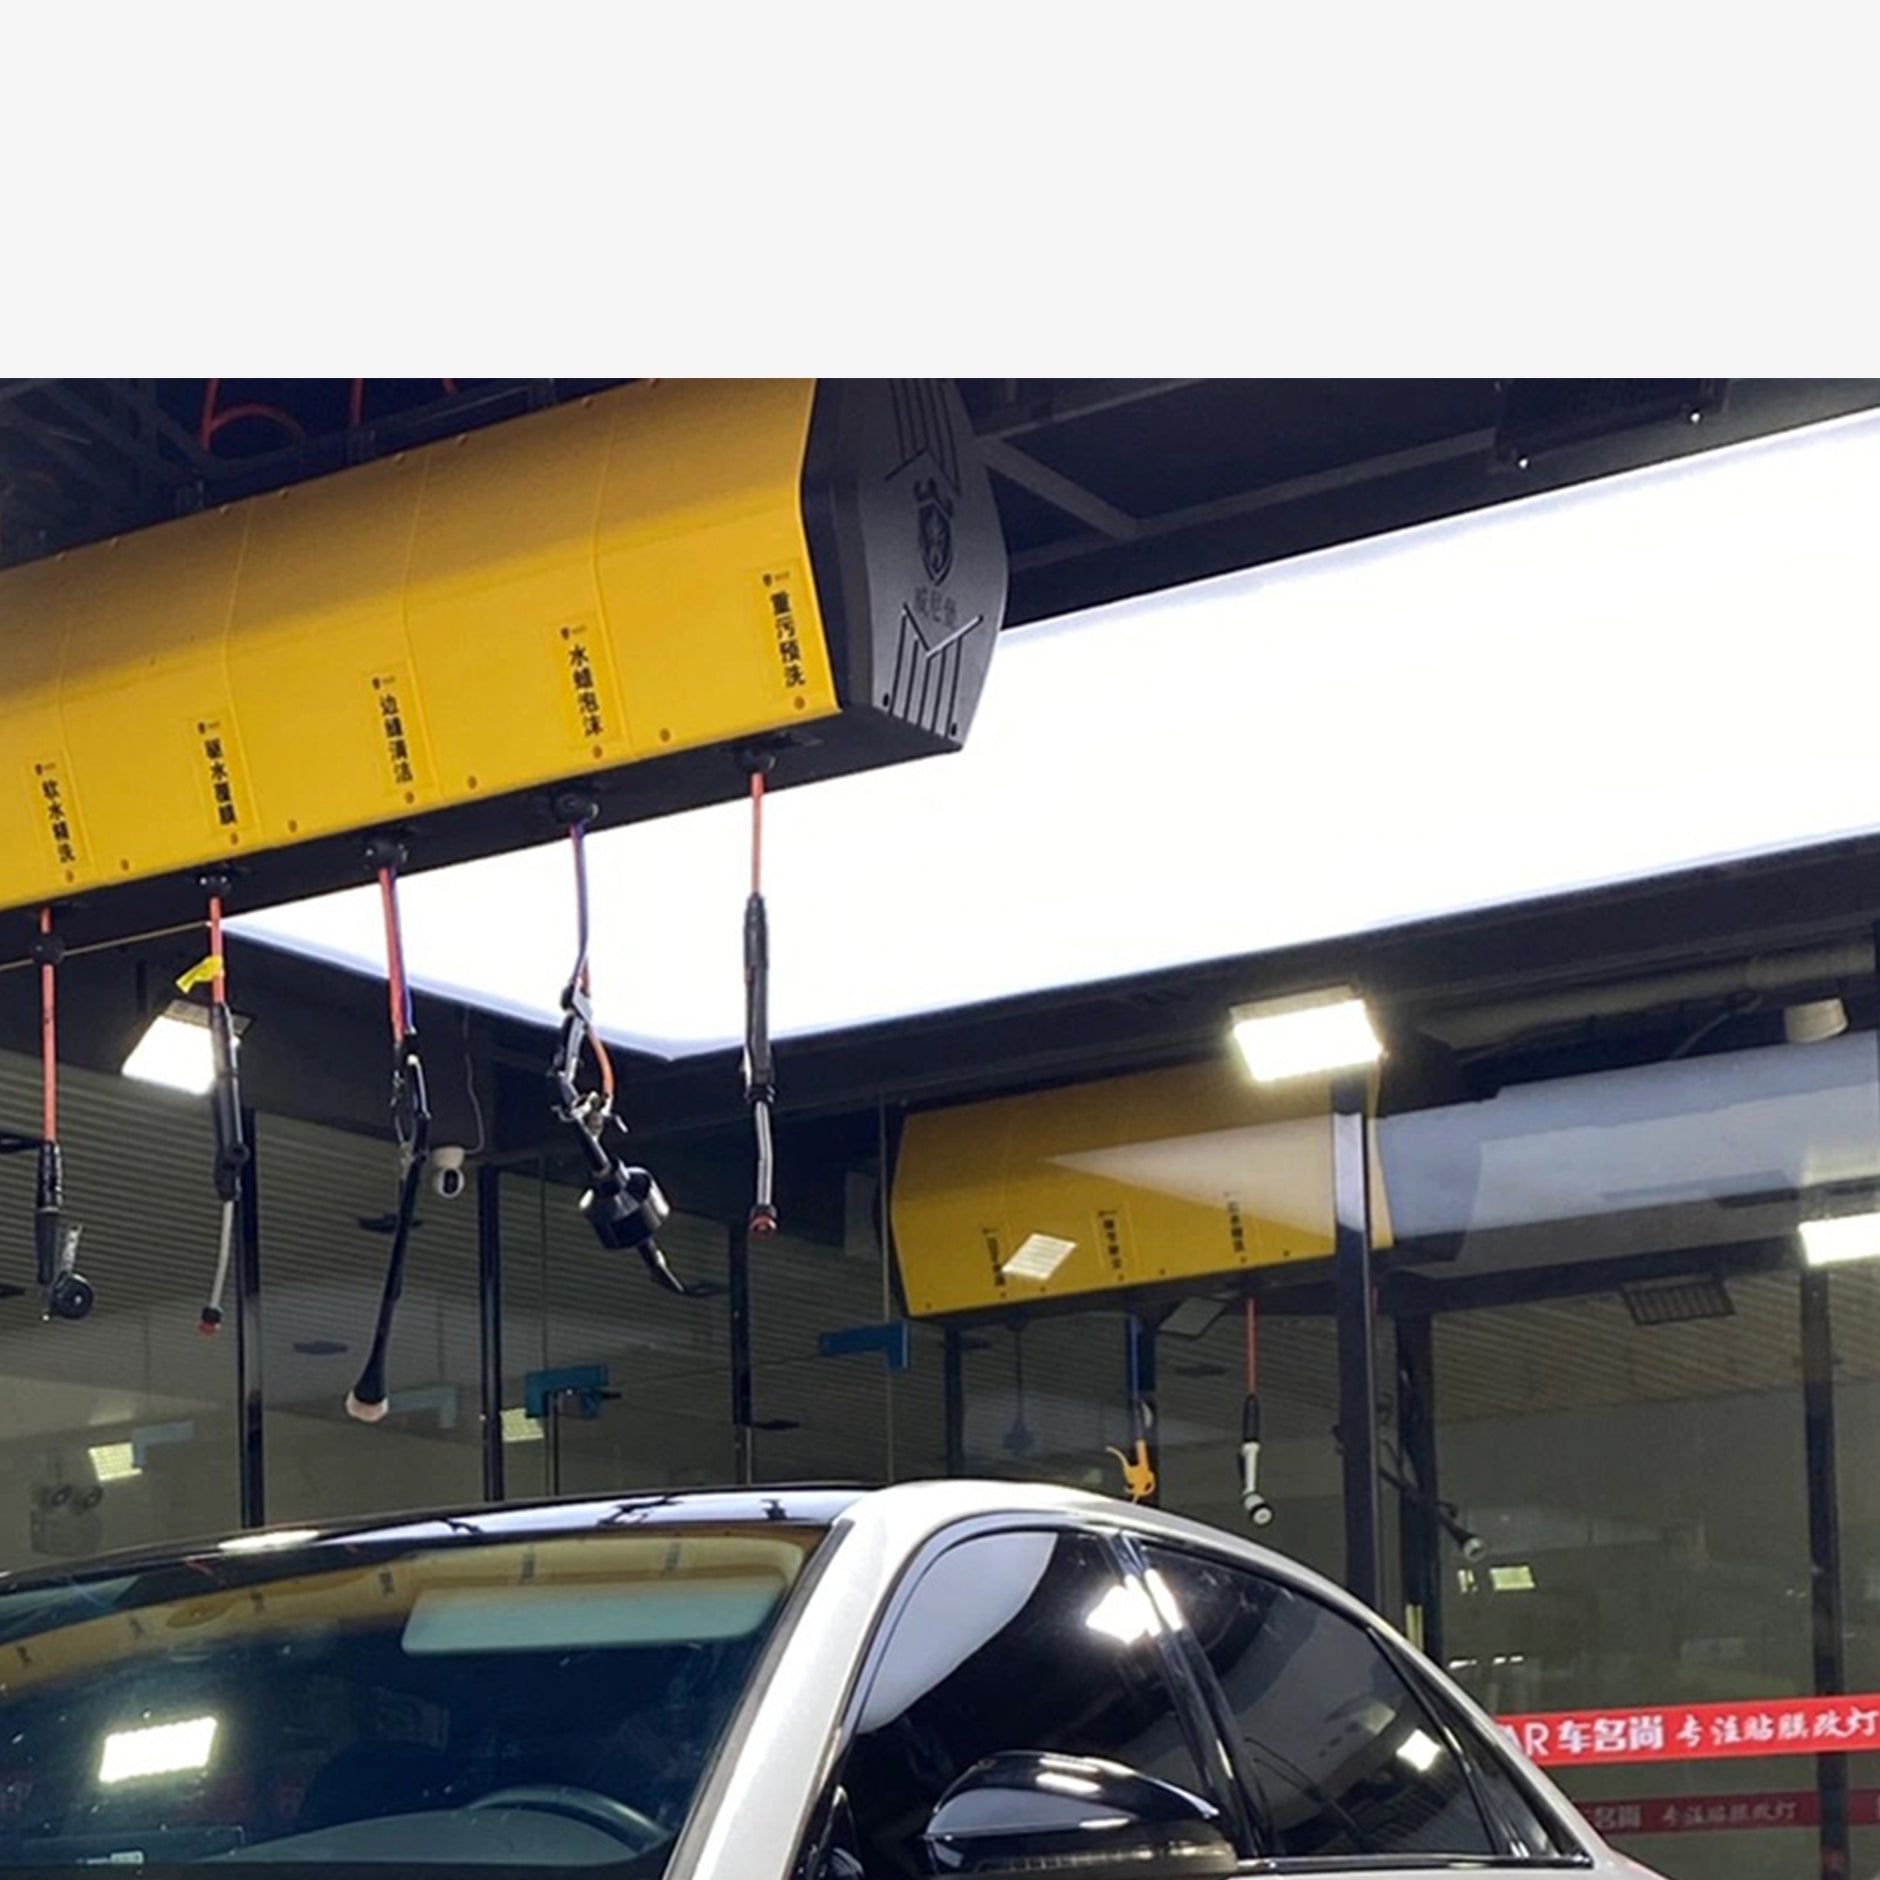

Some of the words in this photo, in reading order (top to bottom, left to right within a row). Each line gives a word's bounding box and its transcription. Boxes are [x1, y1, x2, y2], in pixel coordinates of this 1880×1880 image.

[770, 589, 806, 688] 重污预洗
[568, 643, 604, 738] 水蜡泡沫
[1557, 1716, 1665, 1754] 车名尚
[1676, 1708, 1879, 1749] 专注贴膜改灯
[1583, 1802, 1642, 1830] 名尚
